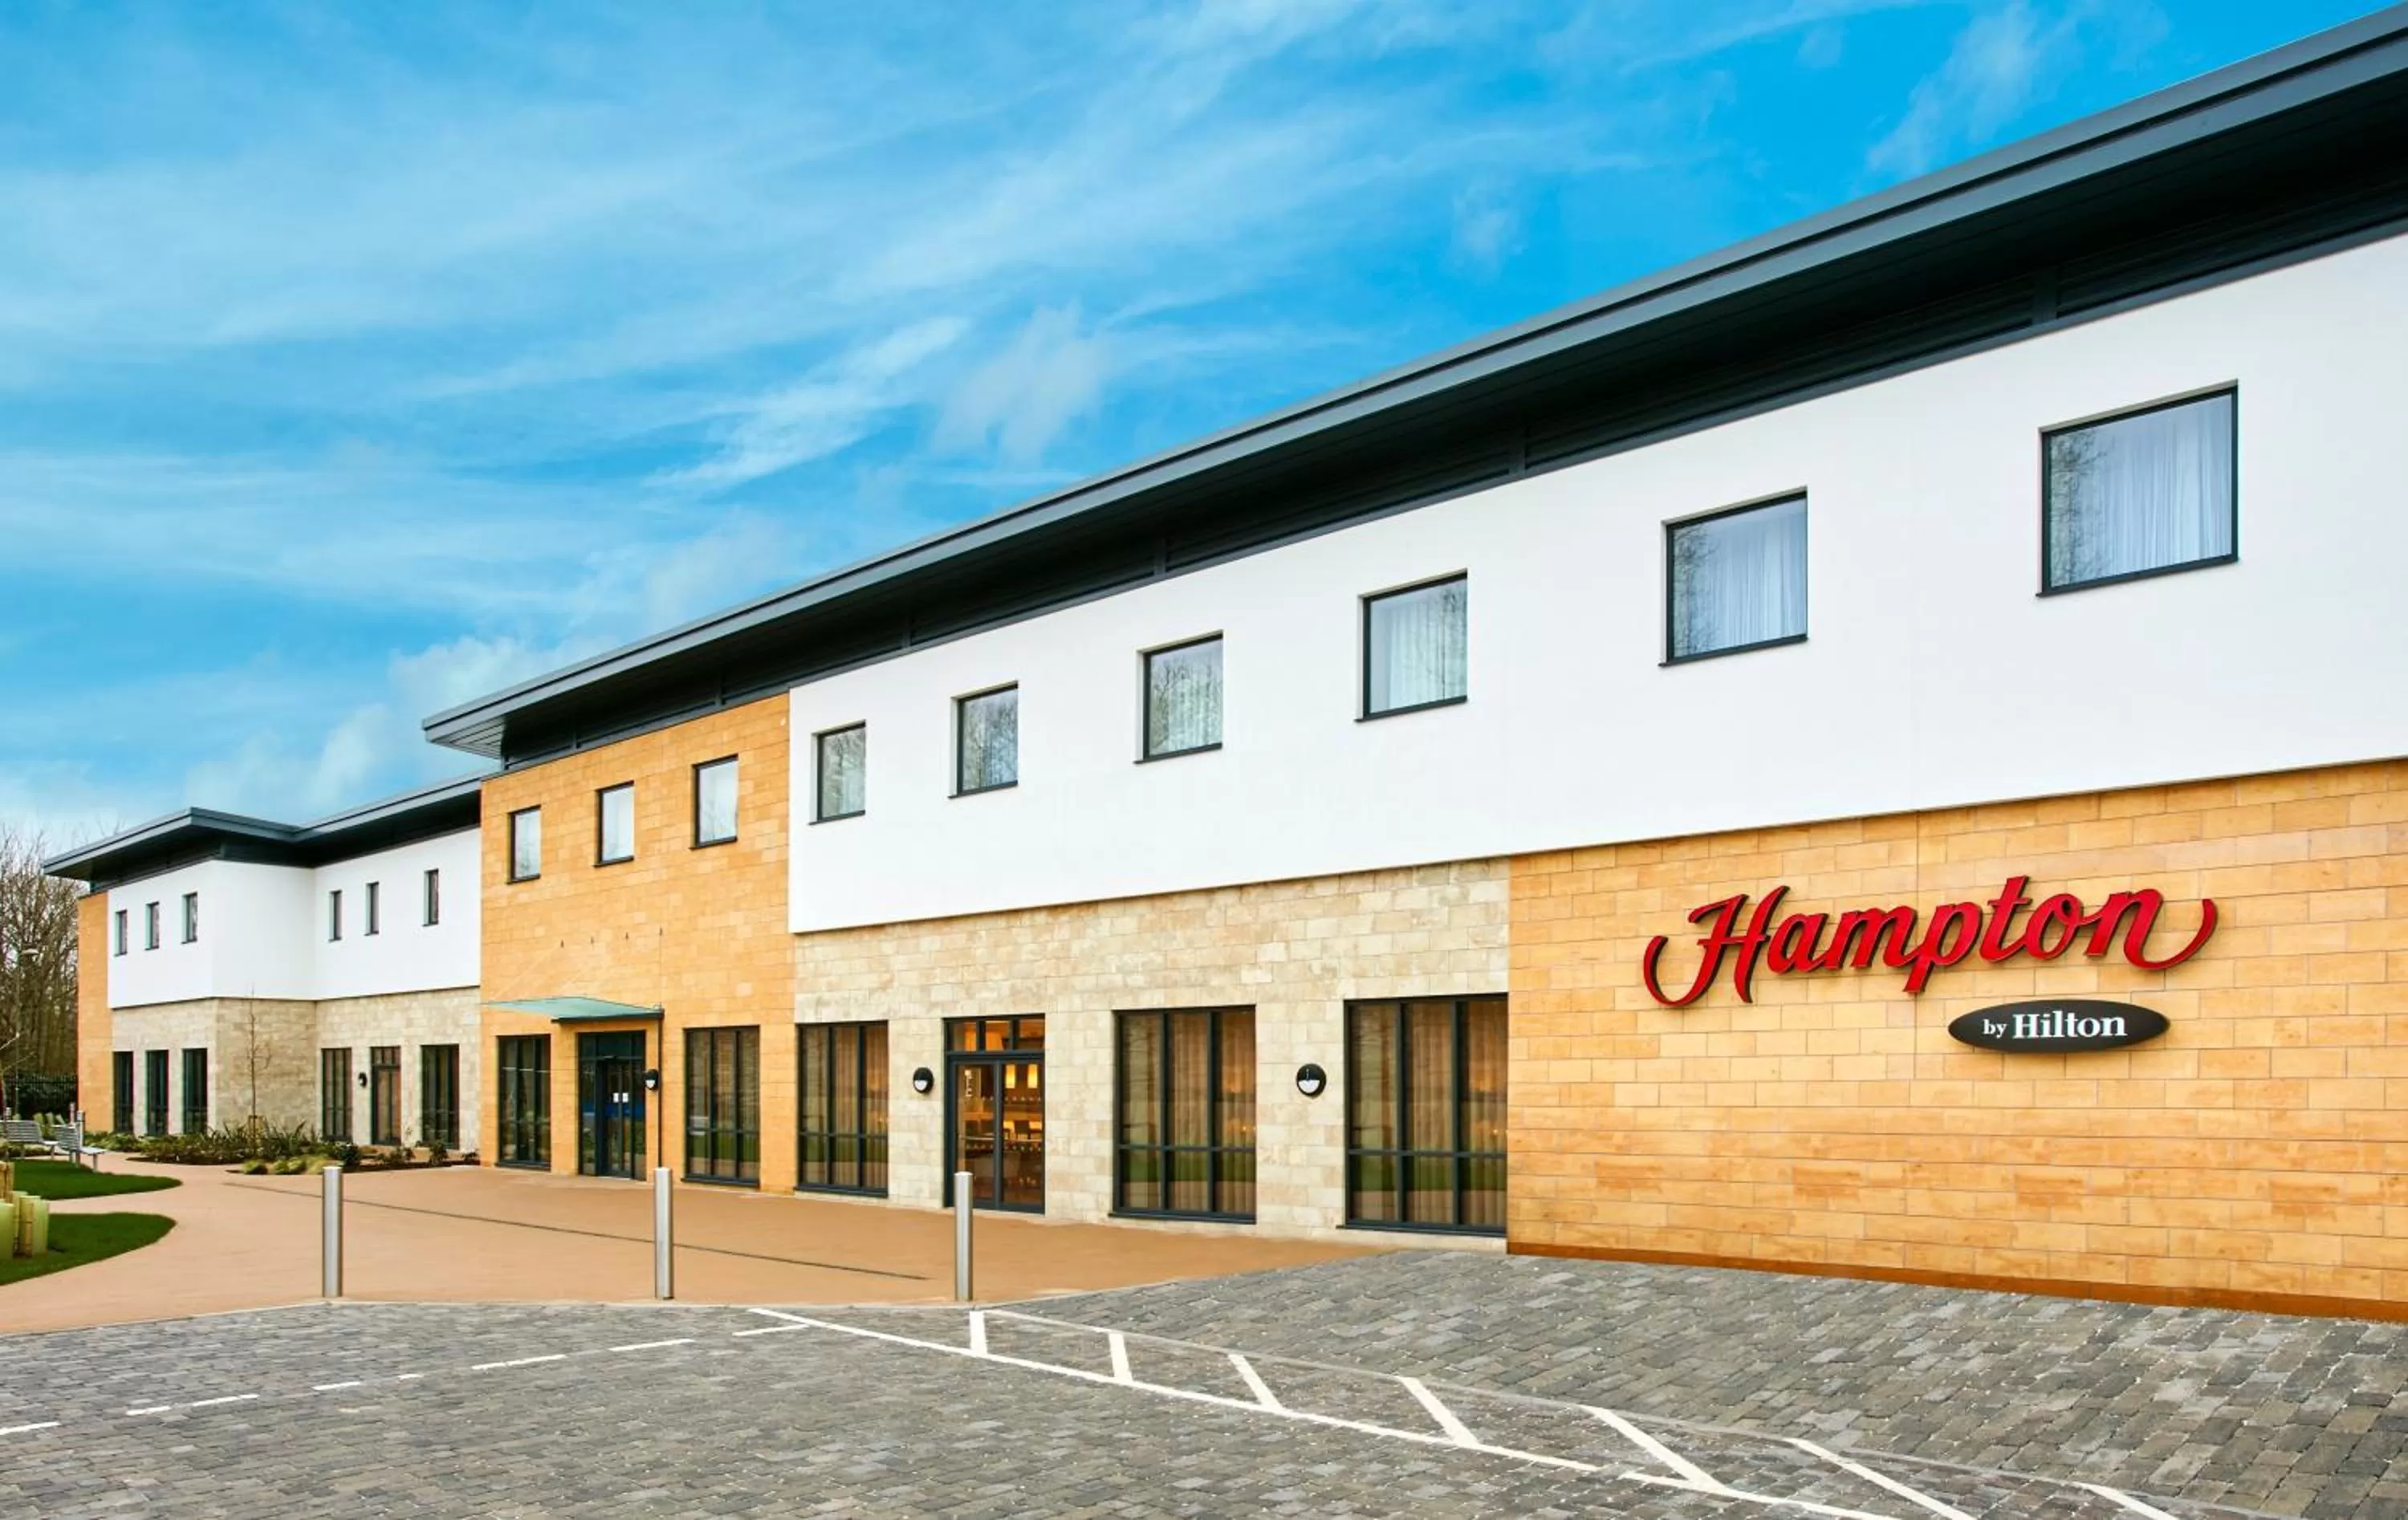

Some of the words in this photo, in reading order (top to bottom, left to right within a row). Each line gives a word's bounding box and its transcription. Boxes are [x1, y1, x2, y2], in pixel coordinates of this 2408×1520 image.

[1644, 876, 2217, 1006] Hampton
[1983, 1018, 2007, 1038] by
[2012, 1010, 2127, 1038] Hilton
